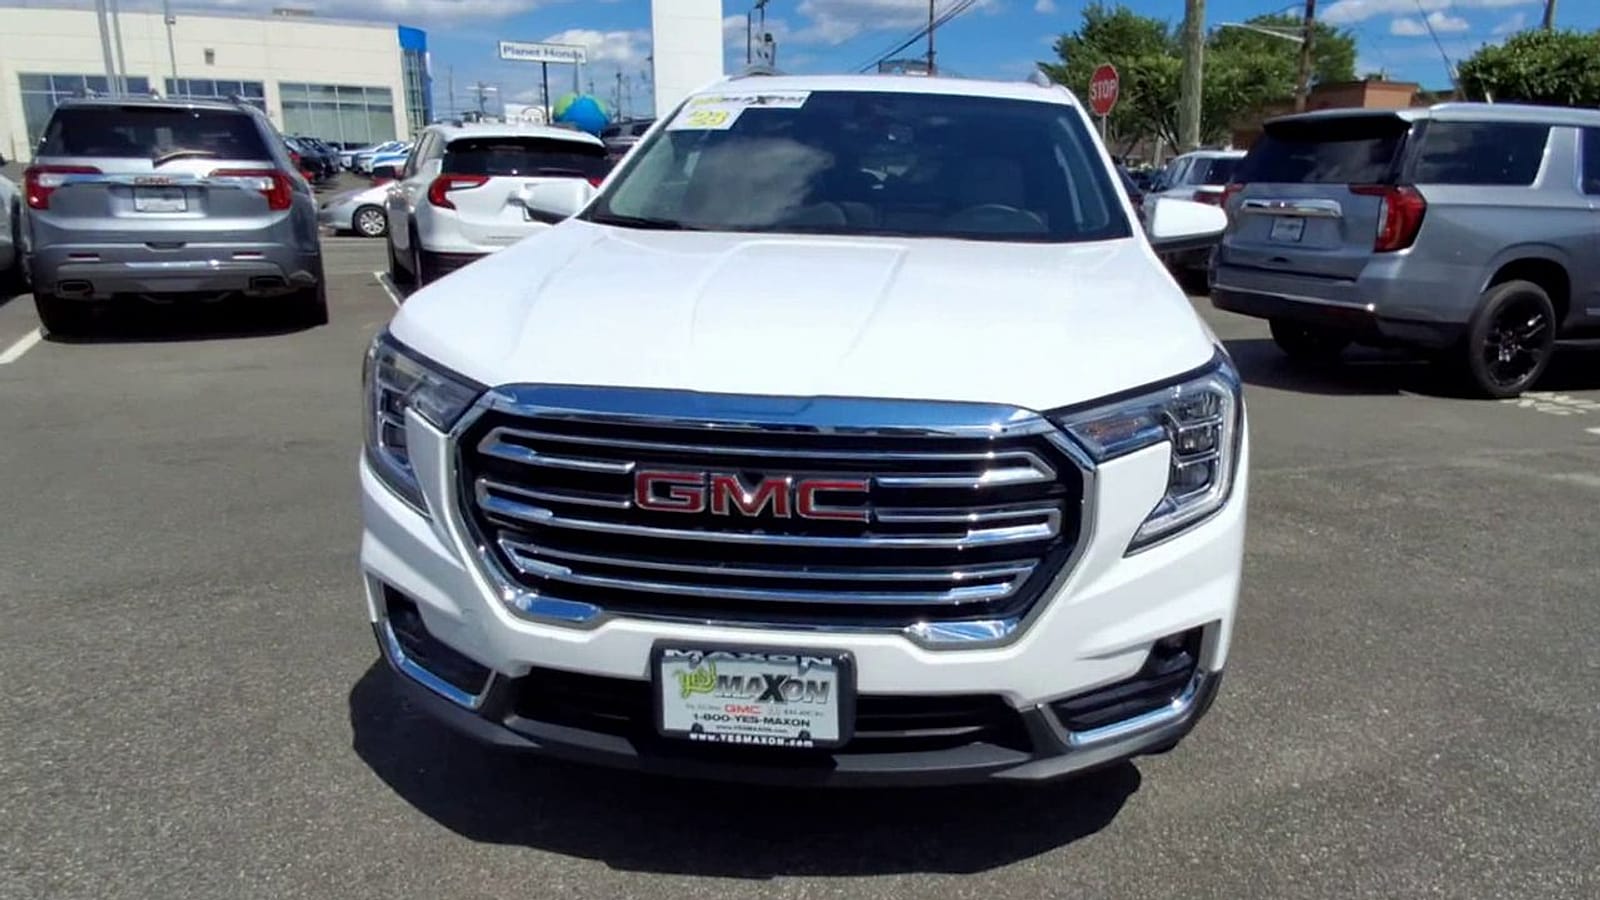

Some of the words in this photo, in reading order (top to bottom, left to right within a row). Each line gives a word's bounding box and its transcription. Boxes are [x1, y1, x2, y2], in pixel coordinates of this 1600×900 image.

[503, 46, 540, 57] Planet
[544, 48, 583, 59] Honda
[1091, 79, 1117, 100] STOP
[634, 470, 870, 522] GMC
[664, 649, 832, 665] MAXON
[724, 704, 762, 714] GMC
[694, 713, 810, 727] 1-800-YES-MAXON
[689, 733, 814, 747] www.YESMAXON.com
